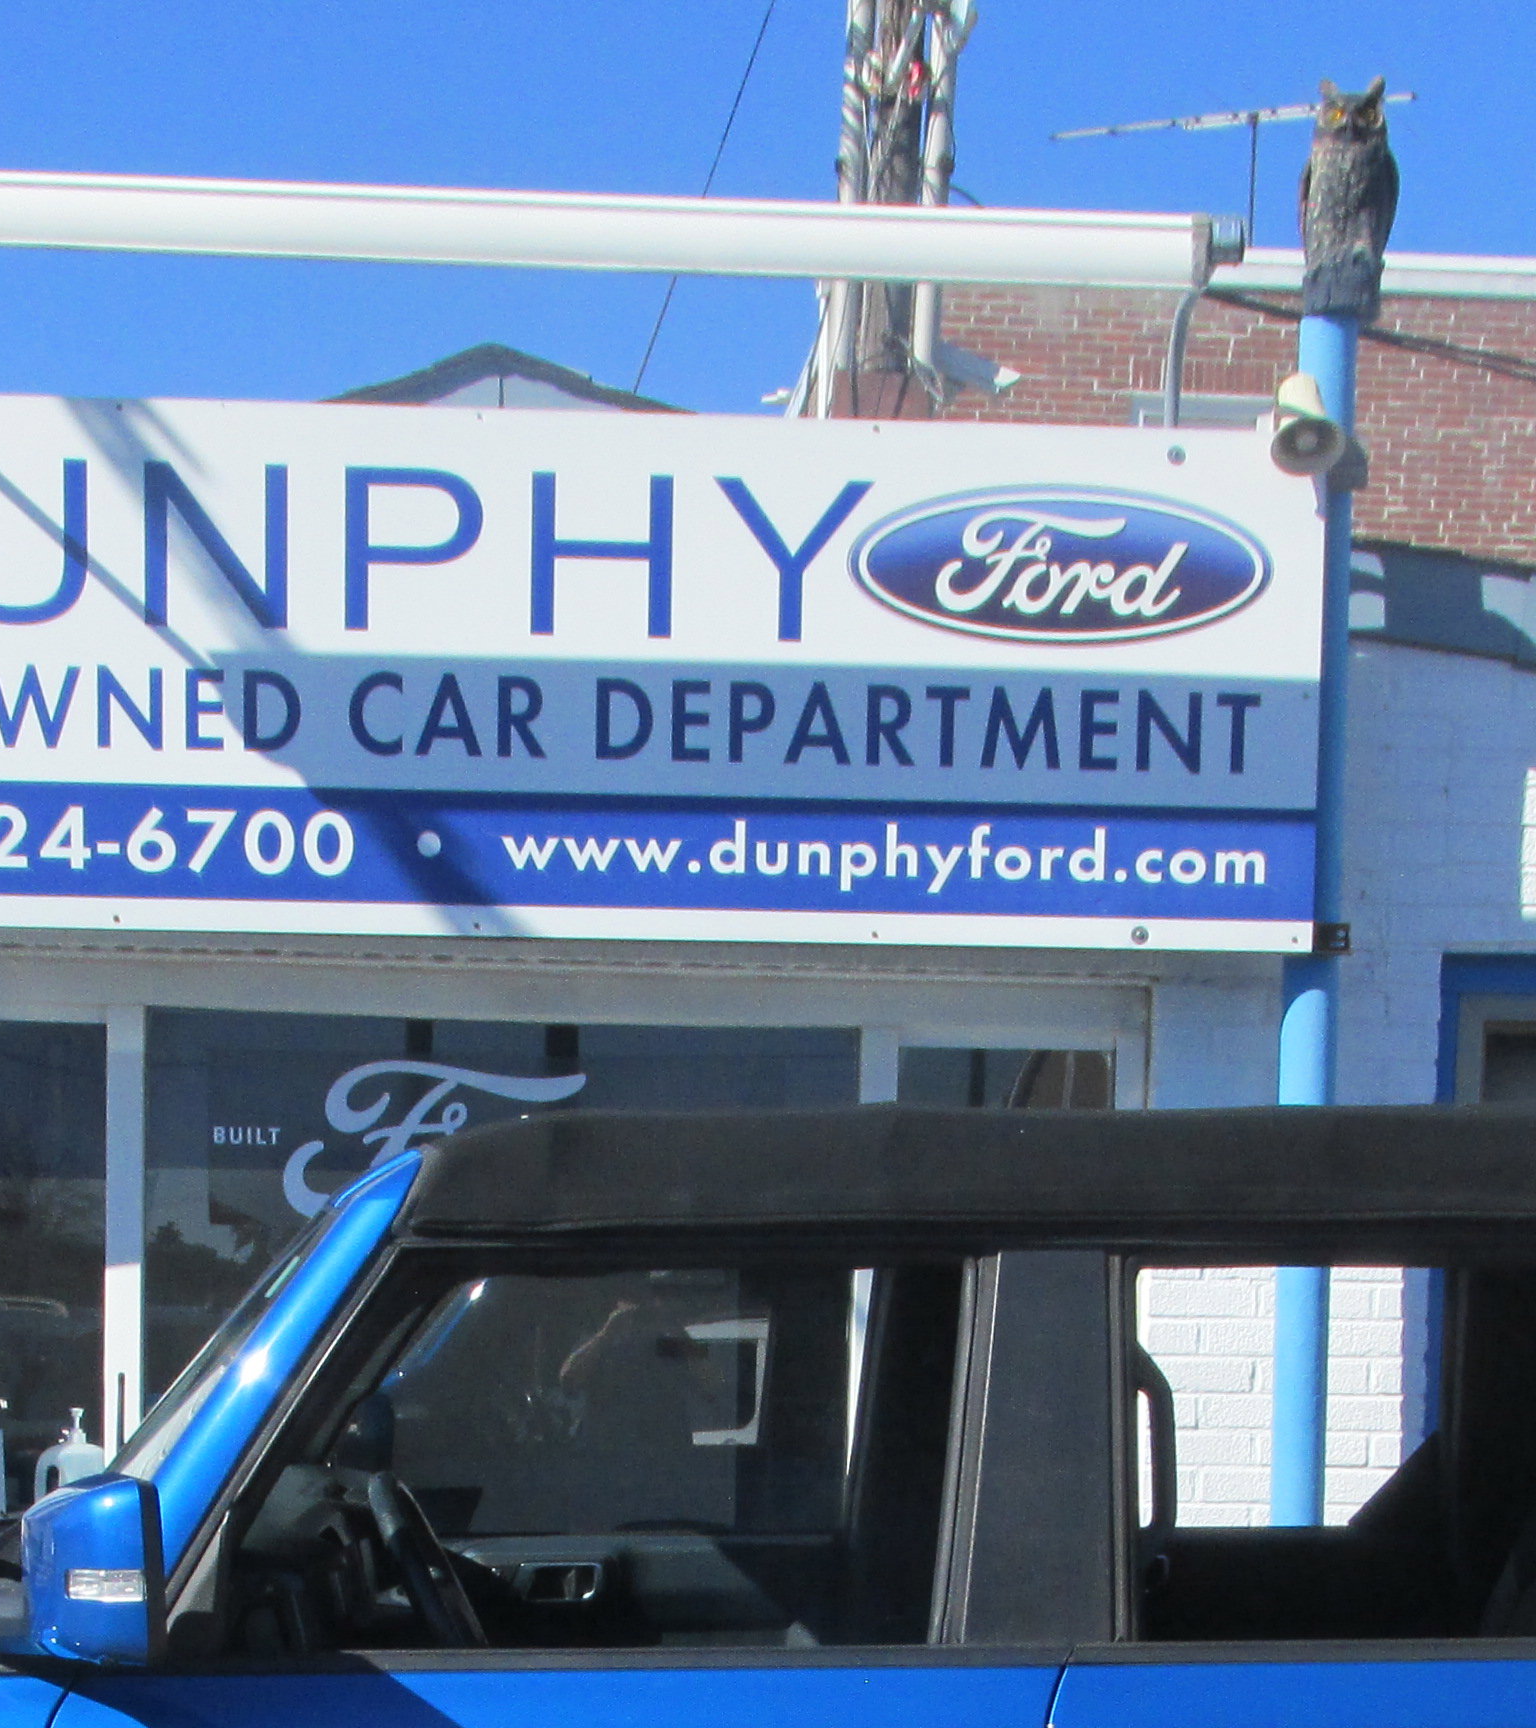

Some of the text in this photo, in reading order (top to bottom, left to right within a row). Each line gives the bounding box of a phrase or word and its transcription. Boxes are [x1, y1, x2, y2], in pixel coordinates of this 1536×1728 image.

[937, 510, 1188, 617] Ford
[348, 671, 547, 759] CAR
[595, 677, 1263, 775] DEPARTMENT
[502, 820, 1267, 893] www.dunphyford.com
[213, 1126, 281, 1145] BUILT
